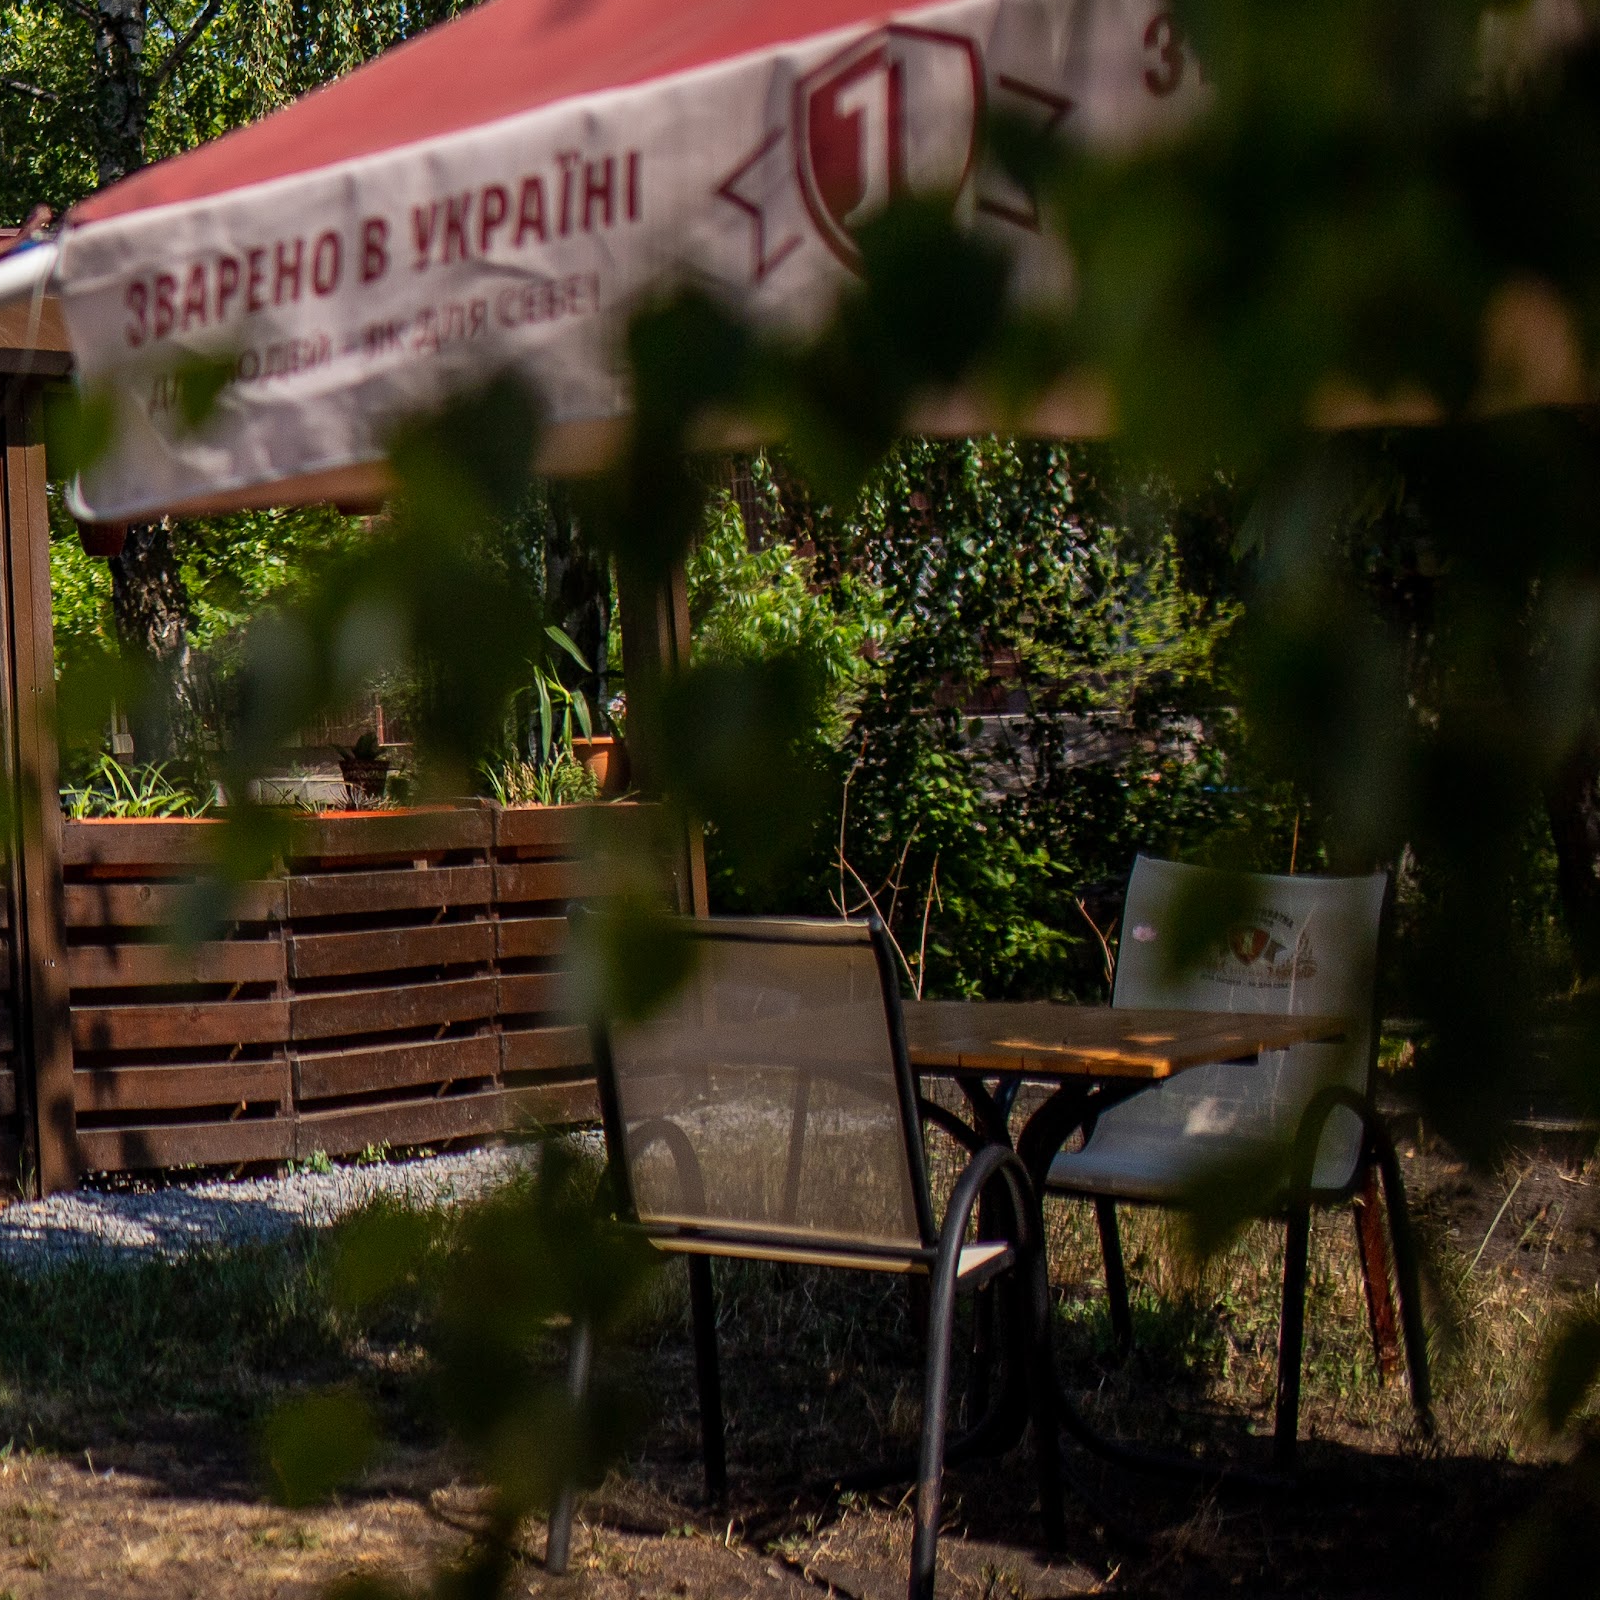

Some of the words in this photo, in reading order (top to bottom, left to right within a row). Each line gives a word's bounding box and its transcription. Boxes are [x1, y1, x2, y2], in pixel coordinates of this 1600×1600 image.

[123, 230, 342, 349] ЗВАРЕНО
[359, 216, 390, 285] В
[411, 148, 643, 272] УКРАЇНІ
